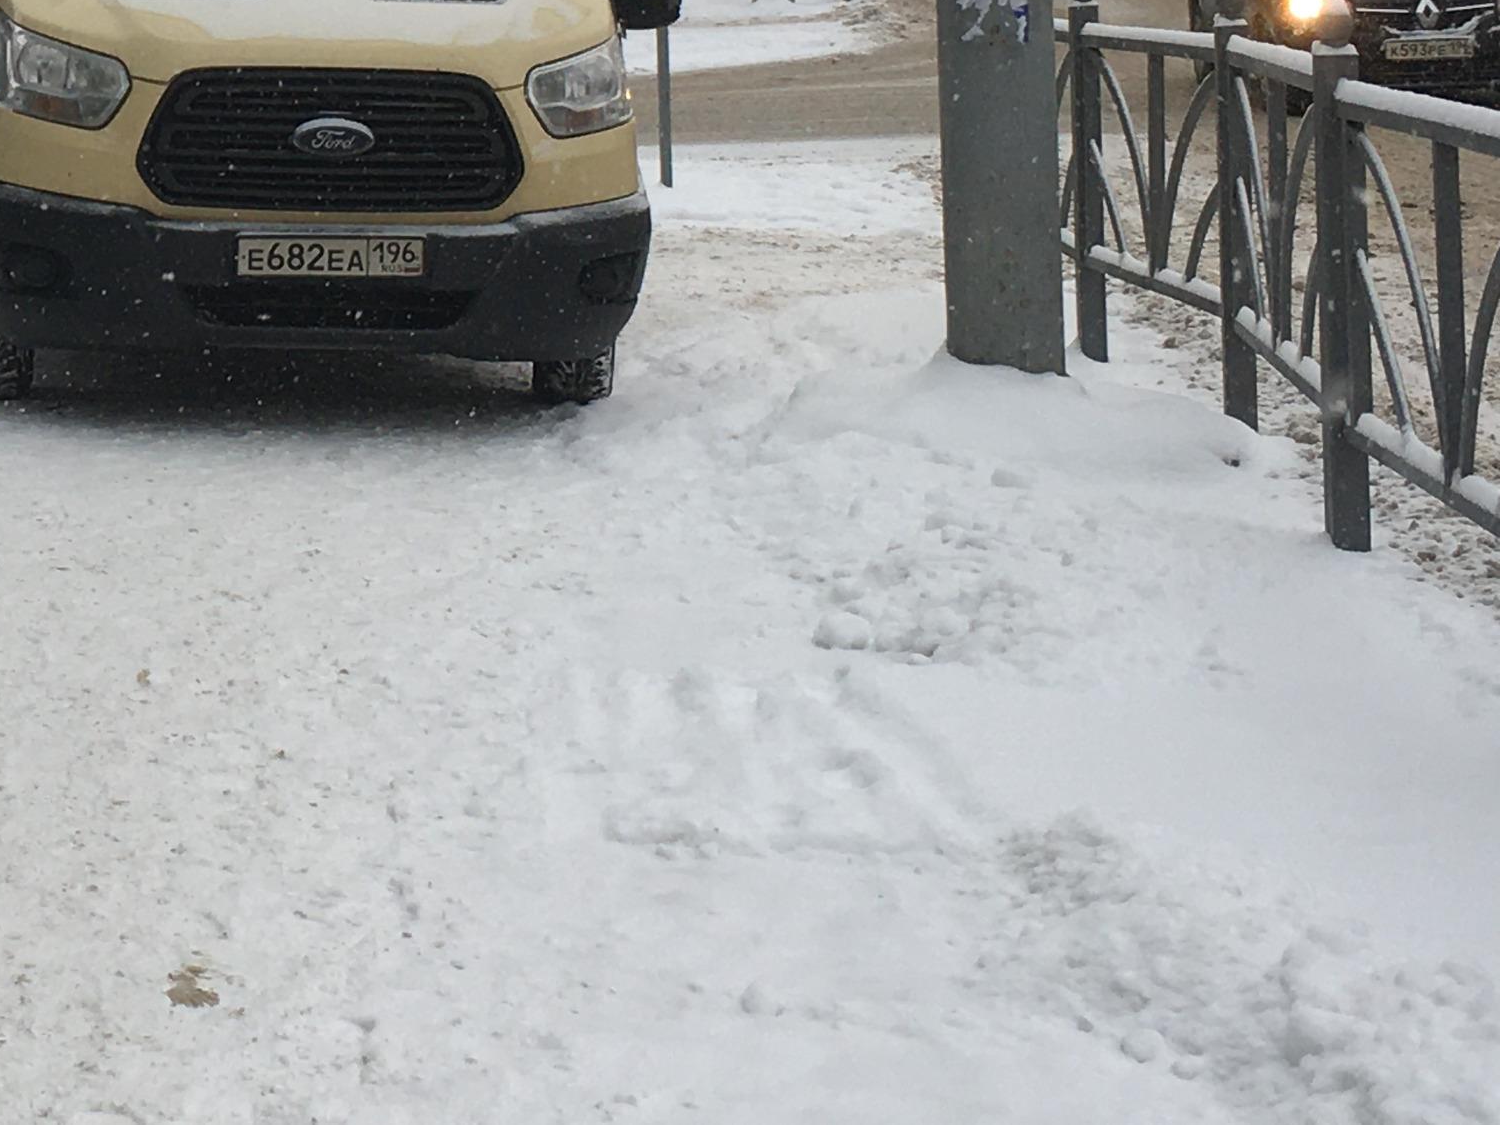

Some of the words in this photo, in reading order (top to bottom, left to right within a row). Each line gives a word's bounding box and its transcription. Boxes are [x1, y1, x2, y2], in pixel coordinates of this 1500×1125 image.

[311, 129, 357, 150] Ford
[247, 242, 364, 272] Е682ЕА
[372, 241, 416, 264] 196
